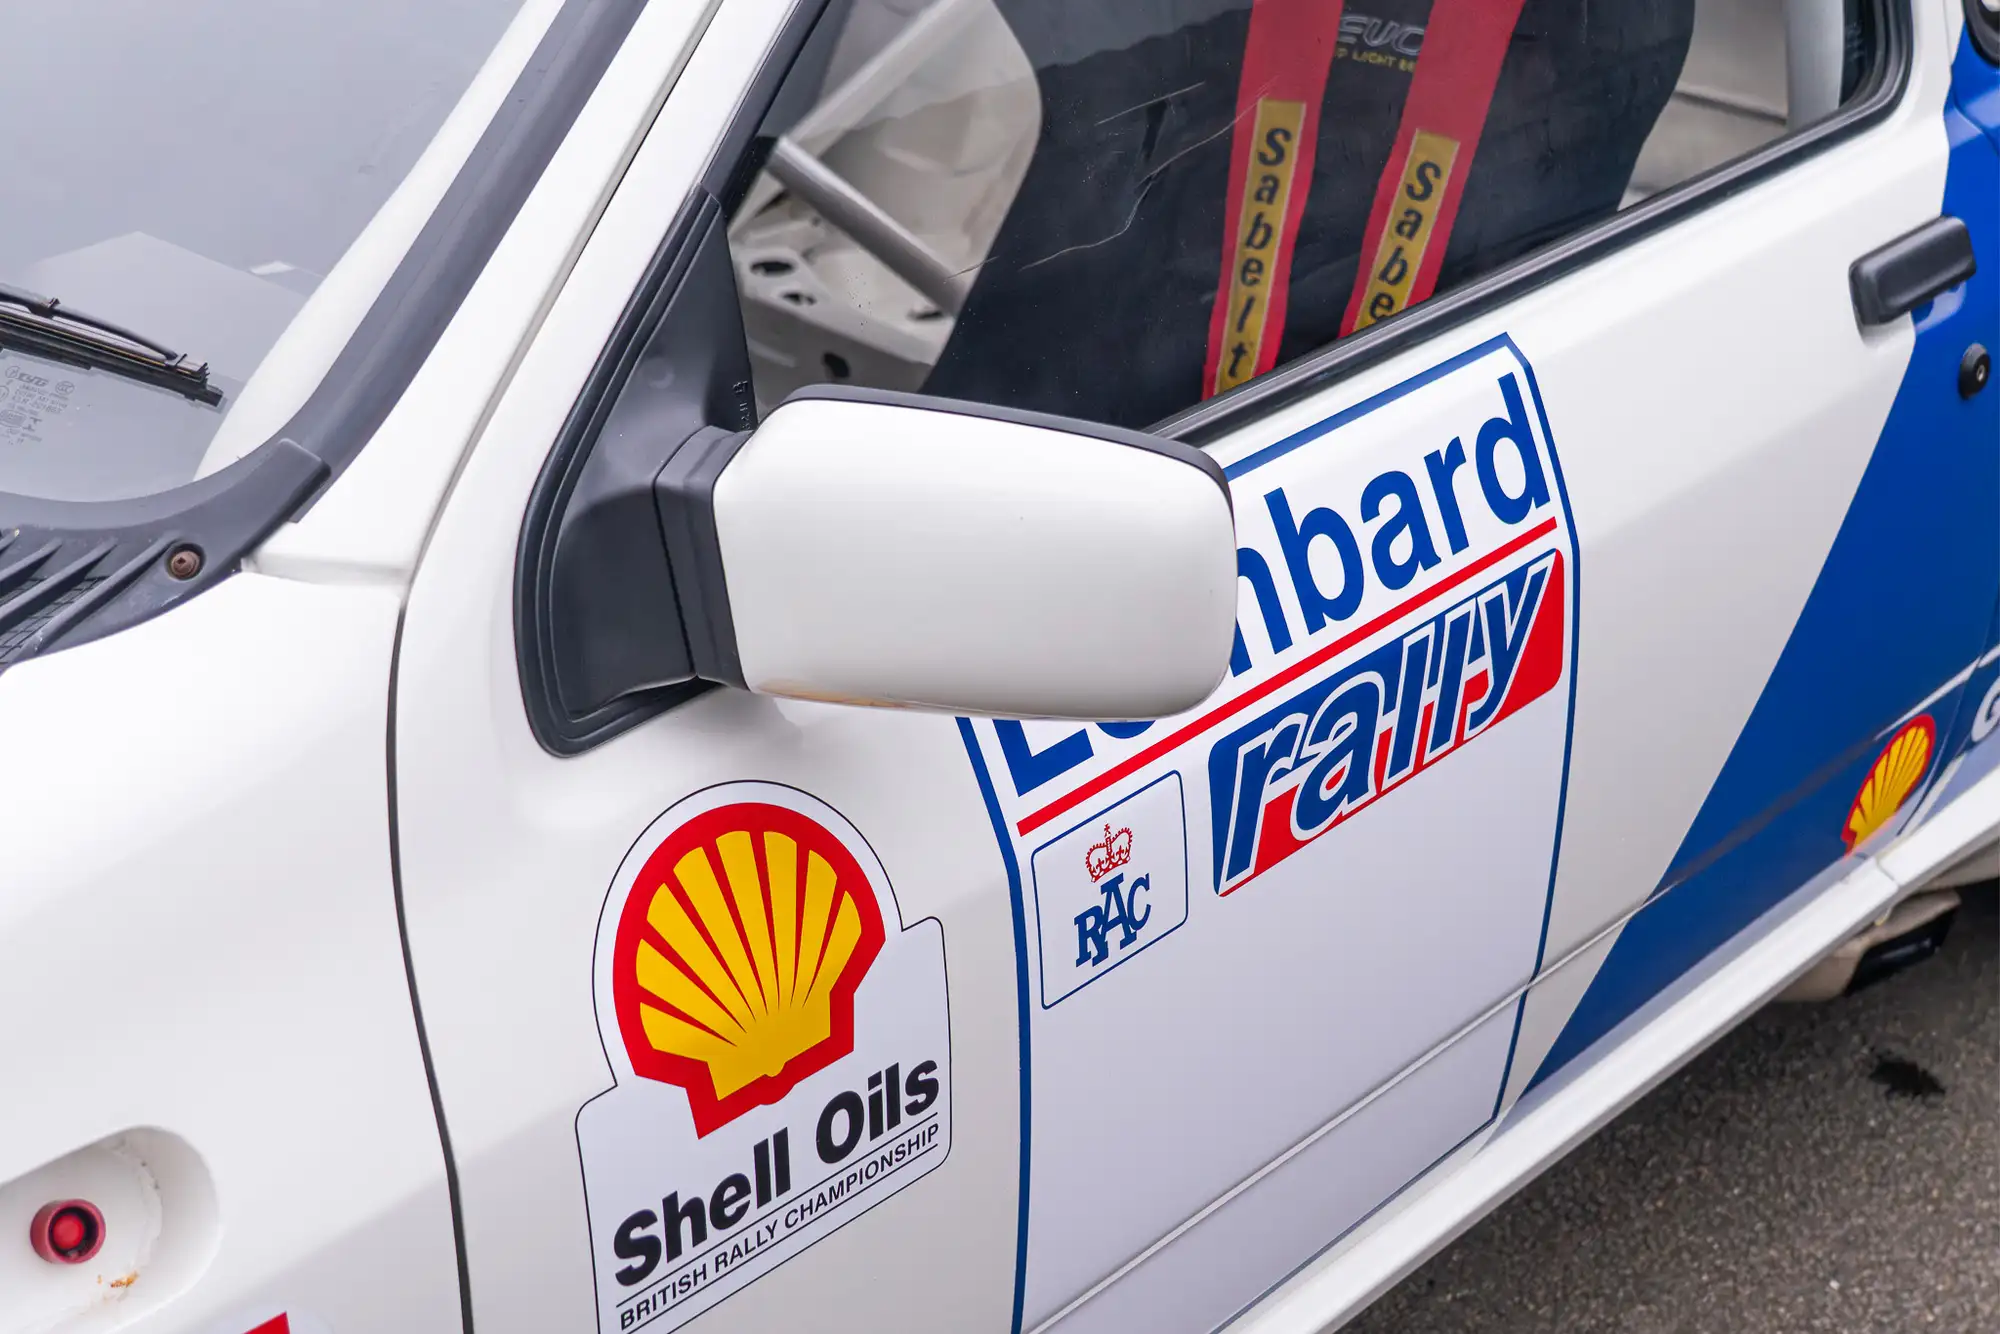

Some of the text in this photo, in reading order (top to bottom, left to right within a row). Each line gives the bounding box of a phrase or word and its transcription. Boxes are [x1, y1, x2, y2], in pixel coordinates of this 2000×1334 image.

[1228, 128, 1292, 378] Sabelt
[1219, 556, 1553, 886] rally
[1074, 873, 1151, 967] RAC
[613, 1060, 940, 1287] Shell Oils
[620, 1123, 940, 1331] BRITISH RALLY CHAMPIONSHIP
